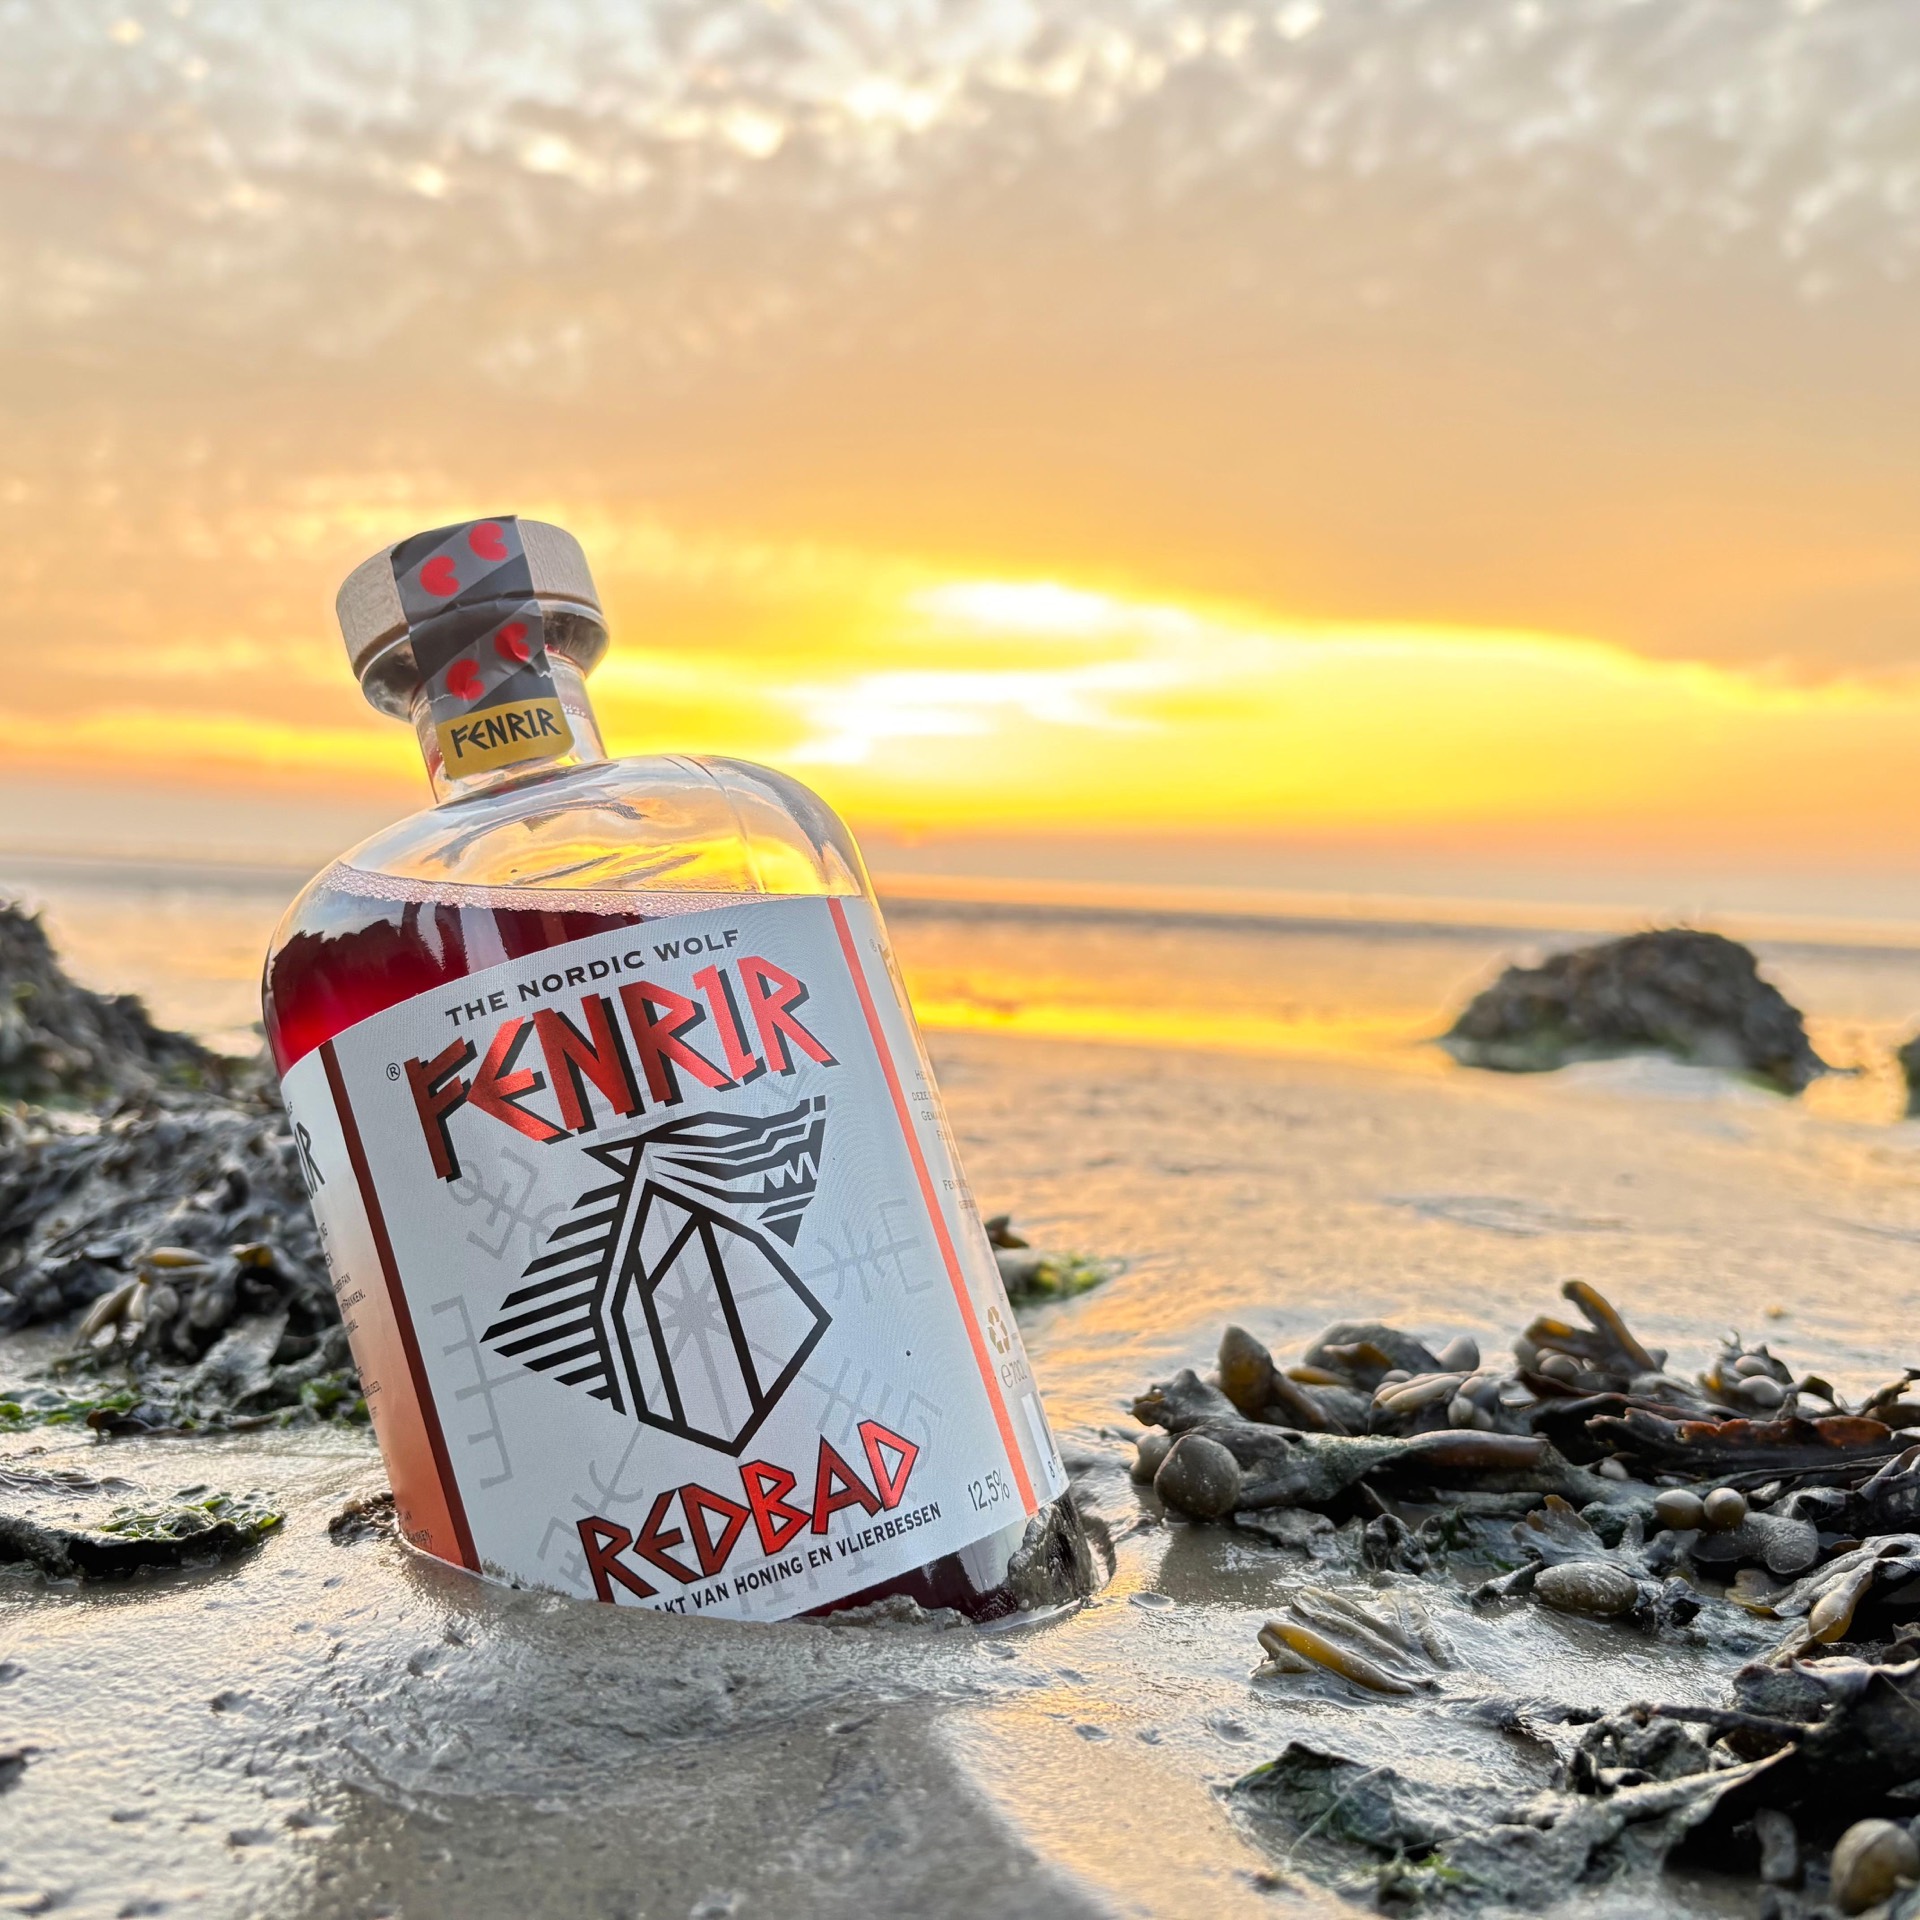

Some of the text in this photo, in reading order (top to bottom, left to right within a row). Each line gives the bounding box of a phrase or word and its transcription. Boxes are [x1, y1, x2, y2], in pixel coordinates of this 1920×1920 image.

[451, 708, 562, 758] FENRIR
[445, 929, 739, 1026] THE NORDIC WOLF
[404, 955, 839, 1183] FENRIR
[577, 1419, 919, 1602] REDBAD
[967, 1467, 1010, 1512] 12,5%
[691, 1583, 730, 1609] VAN
[734, 1556, 804, 1595] HONING
[808, 1545, 833, 1568] EN
[836, 1501, 942, 1557] VLIERBESSEN
